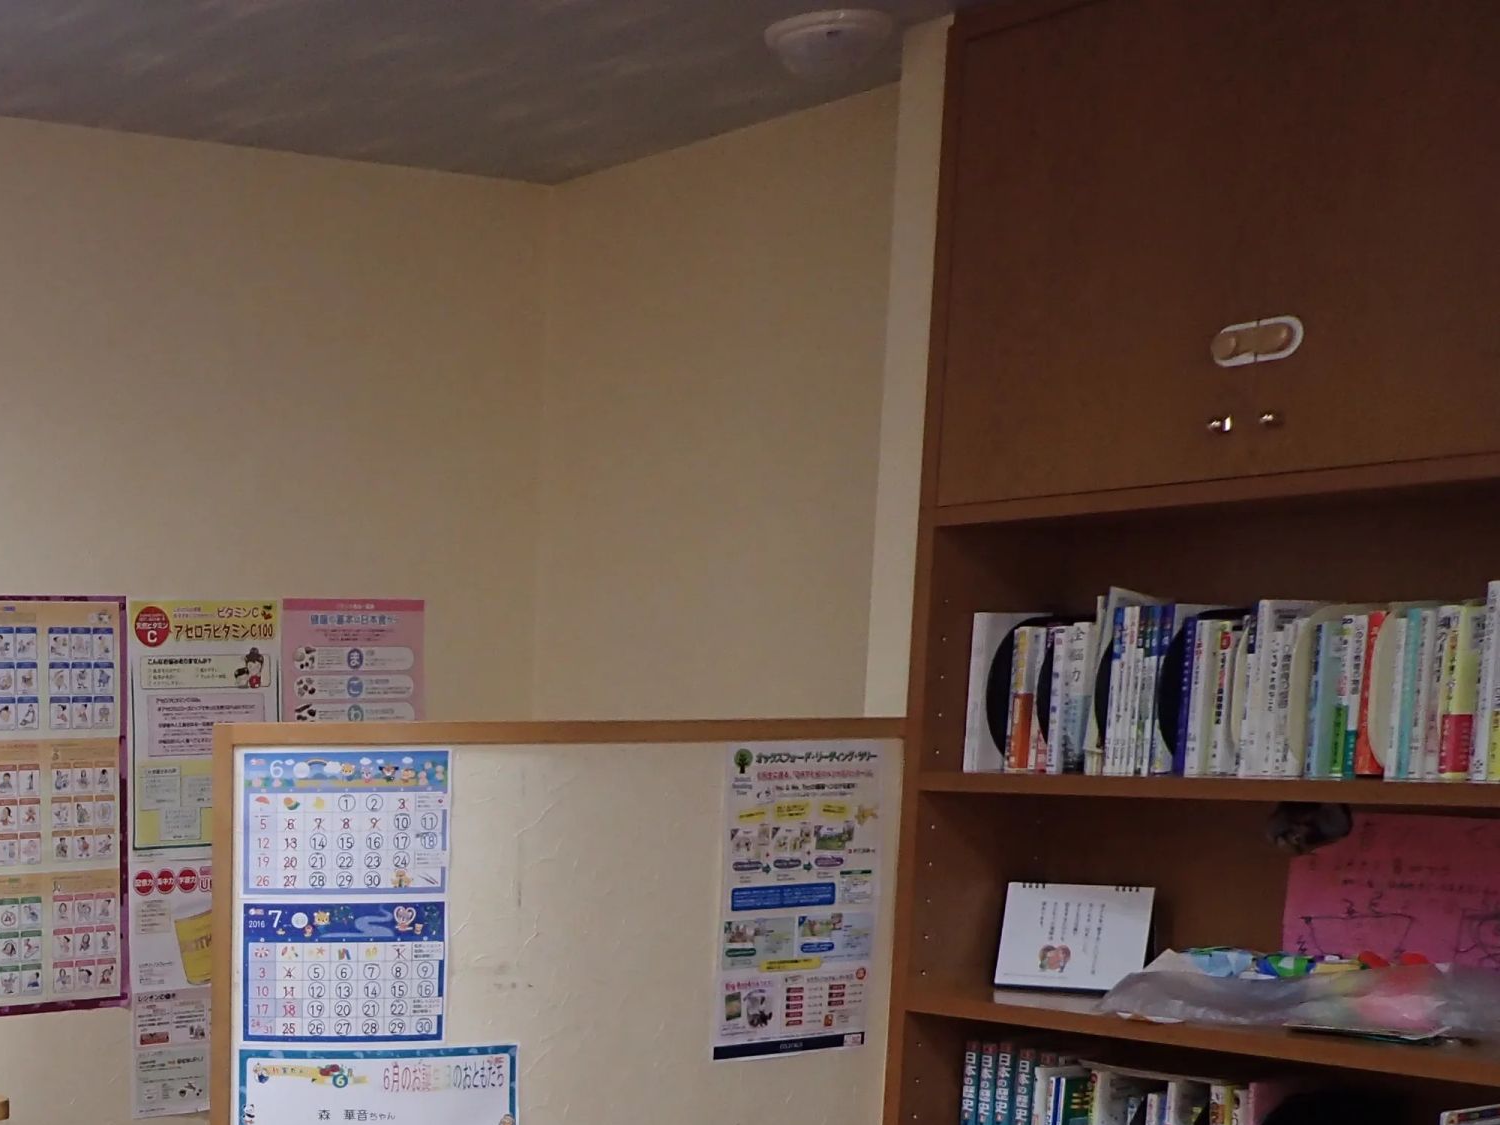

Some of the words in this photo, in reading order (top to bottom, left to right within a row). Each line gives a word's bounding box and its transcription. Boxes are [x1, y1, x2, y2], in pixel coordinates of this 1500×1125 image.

[217, 607, 259, 619] ビタミンC
[147, 630, 158, 643] C
[174, 623, 274, 641] アセロラビタミンC100
[269, 760, 284, 778] 6
[200, 877, 213, 892] U
[248, 920, 266, 928] 2016
[268, 910, 282, 928] 7
[962, 1051, 977, 1114] 日本の歴史
[978, 1054, 993, 1116] 日本の歴史
[995, 1052, 1011, 1115] 日本の歴史
[1015, 1060, 1031, 1122] 日本の歴史
[318, 1109, 331, 1121] 森
[344, 1109, 396, 1121] 華音ちゃん
